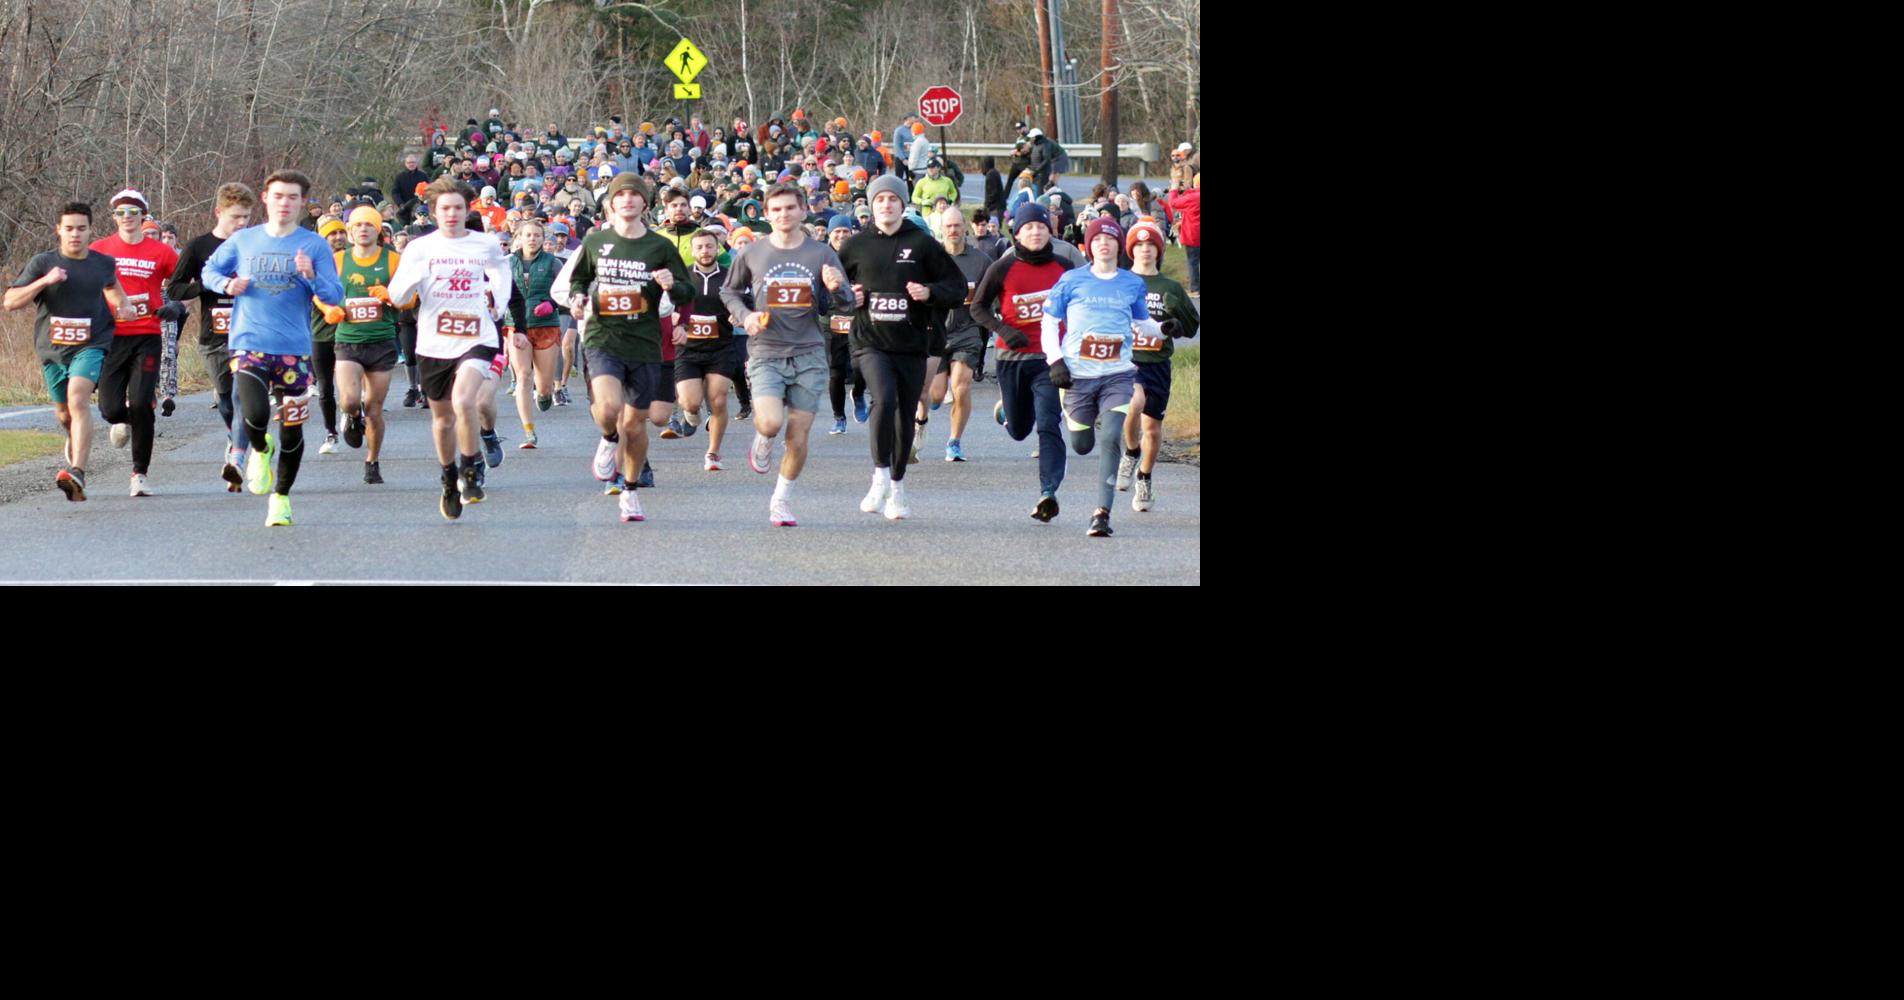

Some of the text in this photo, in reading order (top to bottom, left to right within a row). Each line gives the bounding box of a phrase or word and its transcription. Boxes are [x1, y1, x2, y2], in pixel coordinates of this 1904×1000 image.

[922, 98, 959, 114] STOP
[138, 259, 156, 269] OUT
[245, 256, 296, 274] TRAC
[619, 259, 646, 271] HARD
[618, 269, 653, 281] THANK
[448, 279, 471, 291] XC
[777, 288, 801, 303] 37
[607, 296, 632, 311] 38
[869, 298, 908, 311] 7288
[350, 306, 378, 319] 185
[1017, 303, 1044, 319] 32
[439, 318, 478, 335] 254
[692, 324, 712, 335] 30
[52, 327, 87, 341] 255
[1089, 343, 1114, 358] 131
[287, 405, 309, 421] 22
